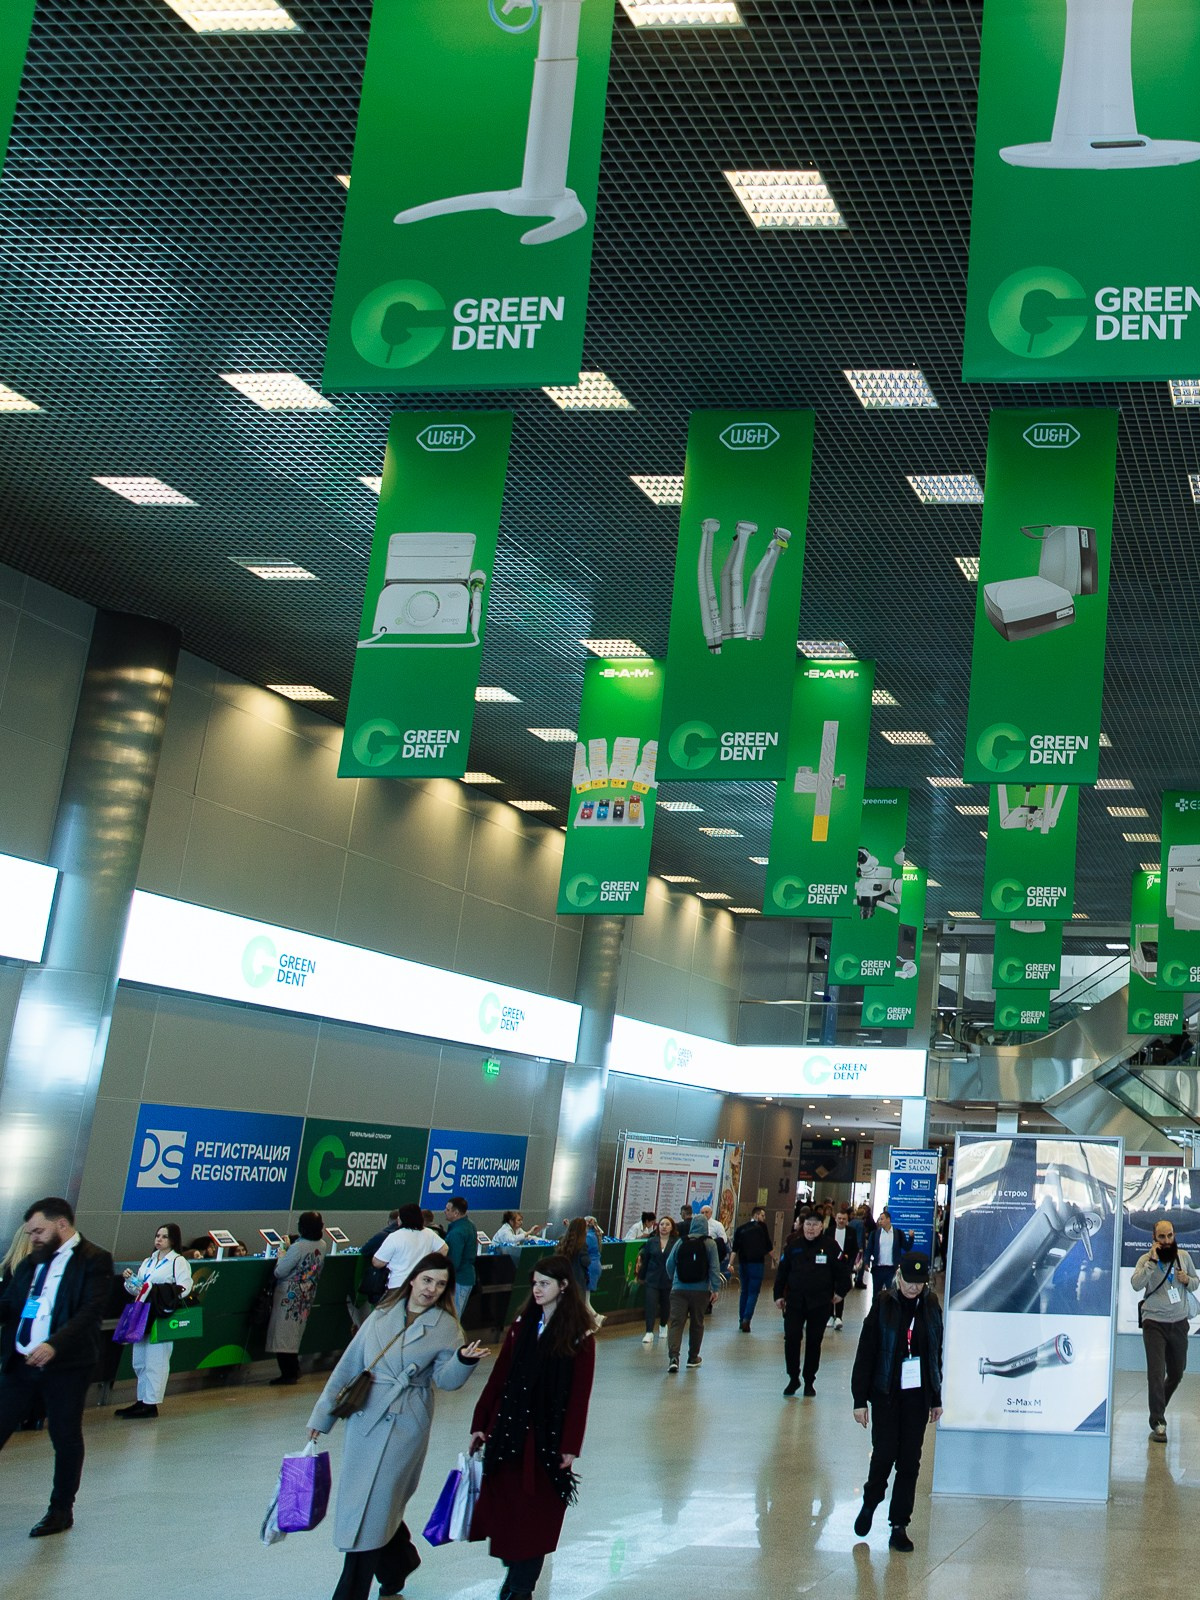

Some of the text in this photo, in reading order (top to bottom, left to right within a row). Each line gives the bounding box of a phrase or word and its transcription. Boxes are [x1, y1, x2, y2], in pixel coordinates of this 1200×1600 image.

[452, 295, 565, 323] GREEN
[1095, 314, 1188, 340] DENT
[451, 323, 541, 351] DENT
[427, 429, 465, 446] W&H
[730, 428, 768, 444] W&H
[1032, 428, 1070, 444] W&H
[402, 729, 460, 744] GREEN
[719, 731, 779, 747] GREEN
[1029, 734, 1089, 750] GREEN
[401, 743, 447, 759] DENT
[719, 746, 766, 761] DENT
[1029, 750, 1078, 765] DENT
[600, 881, 640, 892] GREEN
[807, 883, 848, 894] GREEN
[1026, 886, 1067, 897] GREEN
[600, 890, 632, 902] DENT
[807, 893, 840, 905] DENT
[1027, 897, 1060, 908] DENT
[279, 953, 316, 974] GREEN
[860, 959, 891, 969] GREEN
[1025, 963, 1056, 973] GREEN
[277, 969, 307, 988] DENT
[860, 968, 885, 977] DENT
[1025, 971, 1050, 980] DENT
[502, 1006, 525, 1021] GREEN
[886, 1006, 912, 1014] GREEN
[1020, 1010, 1046, 1018] GREEN
[886, 1013, 907, 1021] DENT
[1020, 1017, 1041, 1025] DENT
[1153, 1013, 1179, 1021] GREEN
[1153, 1019, 1174, 1027] DENT
[500, 1018, 520, 1031] DENT
[833, 1062, 867, 1071] GREEN
[833, 1071, 859, 1080] DENT
[194, 1141, 291, 1163] РЕГИСТРАЦИЯ
[347, 1151, 388, 1170] GREEN
[462, 1157, 520, 1173] РЕГИСТРАЦИЯ
[191, 1164, 288, 1182] REGISTRATION
[344, 1169, 378, 1187] DENT
[460, 1174, 518, 1188] REGISTRATION
[913, 1180, 919, 1189] 3
[1003, 1190, 1028, 1199] строю
[1006, 1397, 1032, 1406] S-Max
